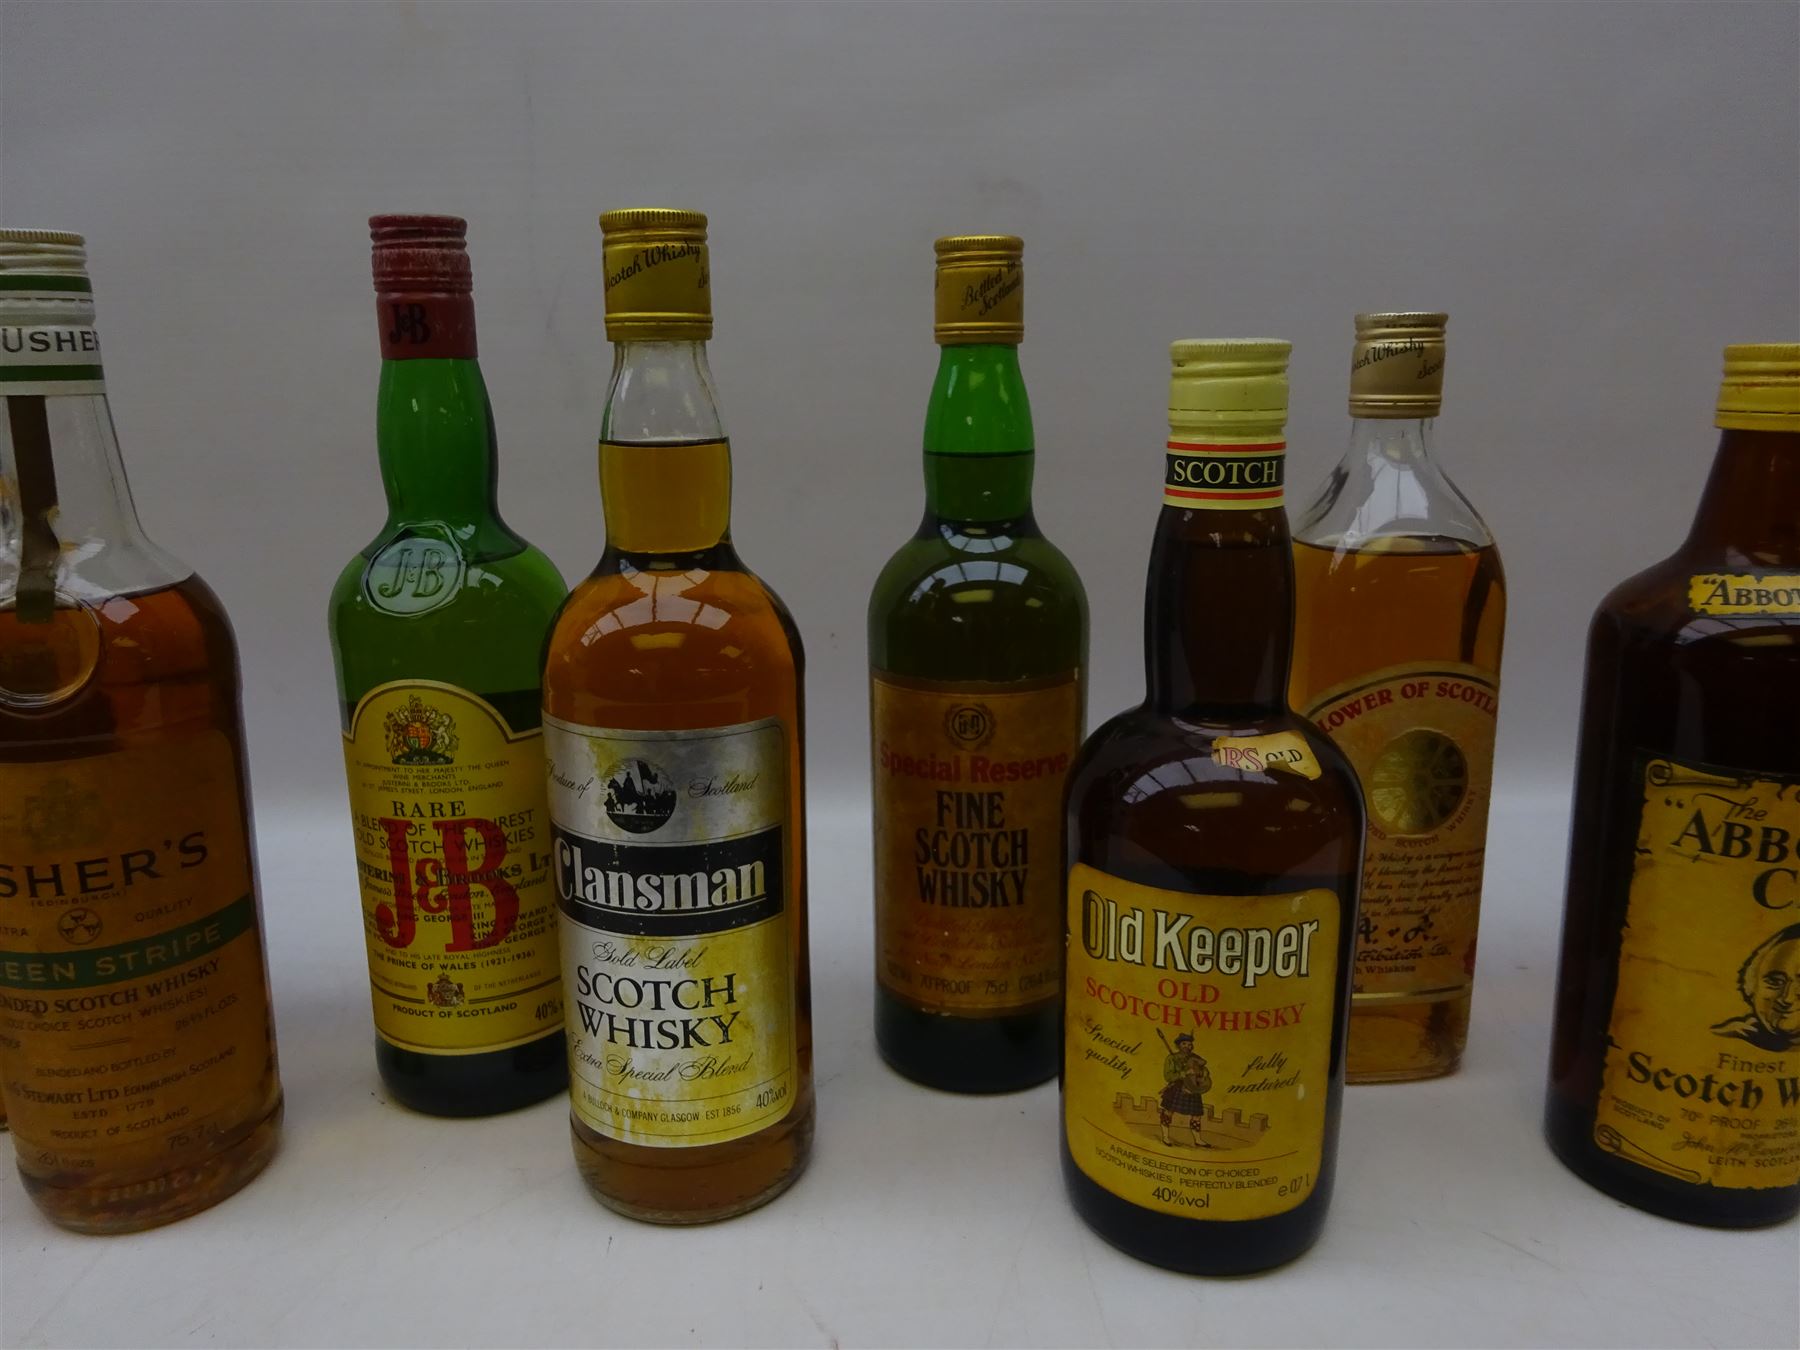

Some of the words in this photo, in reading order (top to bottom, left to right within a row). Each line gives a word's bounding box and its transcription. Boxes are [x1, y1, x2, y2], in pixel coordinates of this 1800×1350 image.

[642, 240, 701, 265] Whisky
[1371, 337, 1424, 362] Whisky
[1174, 459, 1278, 485] SCOTCH
[378, 548, 444, 598] J&B
[1400, 682, 1430, 698] OF
[881, 741, 961, 782] Special
[970, 752, 1069, 784] Reserve
[577, 777, 594, 799] of
[688, 773, 760, 799] Scotland
[391, 801, 466, 817] RARE
[936, 790, 1006, 830] FINE
[405, 823, 427, 837] OF
[1394, 834, 1441, 849] SCOTCH
[379, 836, 444, 854] SCOTCH
[915, 827, 1029, 869] SCOTCH
[375, 814, 520, 954] J&B
[554, 837, 767, 911] Clansman
[916, 866, 1029, 908] WHISKY
[134, 897, 194, 923] QUALITY
[504, 925, 546, 944] GEORGE
[1082, 889, 1146, 967] Old
[1152, 908, 1320, 988] Keeper
[96, 922, 222, 977] STRIPE
[387, 956, 417, 969] PRINCE
[421, 962, 435, 970] OF
[439, 961, 477, 971] WALES
[444, 953, 471, 961] ROYAL
[592, 942, 638, 968] Gold
[644, 946, 708, 970] Label
[54, 988, 138, 1014] SCOTCH
[144, 958, 220, 998] WHISKY
[577, 965, 738, 1011] SCOTCH
[1157, 978, 1221, 1004] OLD
[393, 1003, 434, 1018] PRODUCT
[438, 1010, 453, 1018] OF
[457, 1002, 518, 1018] SCOTLAND
[1085, 976, 1185, 1028] SCOTCH
[1190, 1003, 1307, 1032] WHISKY
[78, 1013, 132, 1031] SCOTCH
[577, 1000, 740, 1050] WHISKY
[1083, 1022, 1143, 1056] Special
[84, 1064, 108, 1076] AND
[110, 1053, 161, 1072] BOTTLED
[606, 1053, 681, 1085] Special
[678, 1053, 755, 1082] Blend
[1084, 1048, 1133, 1081] quality
[1240, 1050, 1289, 1079] fully
[1717, 1052, 1787, 1074] Finest
[87, 1087, 119, 1103] LTD
[123, 1071, 187, 1097] EDINBURGH
[1225, 1069, 1303, 1095] matured
[1626, 1051, 1764, 1112] Scotch
[106, 1126, 120, 1136] OF
[126, 1105, 189, 1132] SCOTLAND
[621, 1108, 658, 1122] COMPANY
[660, 1112, 700, 1123] GLASGOW
[705, 1108, 719, 1121] EST
[722, 1104, 742, 1117] 1856
[1709, 1114, 1761, 1131] PROOF
[1096, 1146, 1126, 1169] SCOTCH
[1127, 1163, 1173, 1184] WHISKIES
[1180, 1177, 1235, 1190] PERFECTLY
[1236, 1175, 1279, 1190] BLENDED
[1115, 1146, 1140, 1163] RARE
[1142, 1156, 1197, 1176] SELECTION
[1199, 1168, 1214, 1177] OF
[1215, 1167, 1260, 1178] CHOICED
[1708, 1155, 1746, 1168] LEITH
